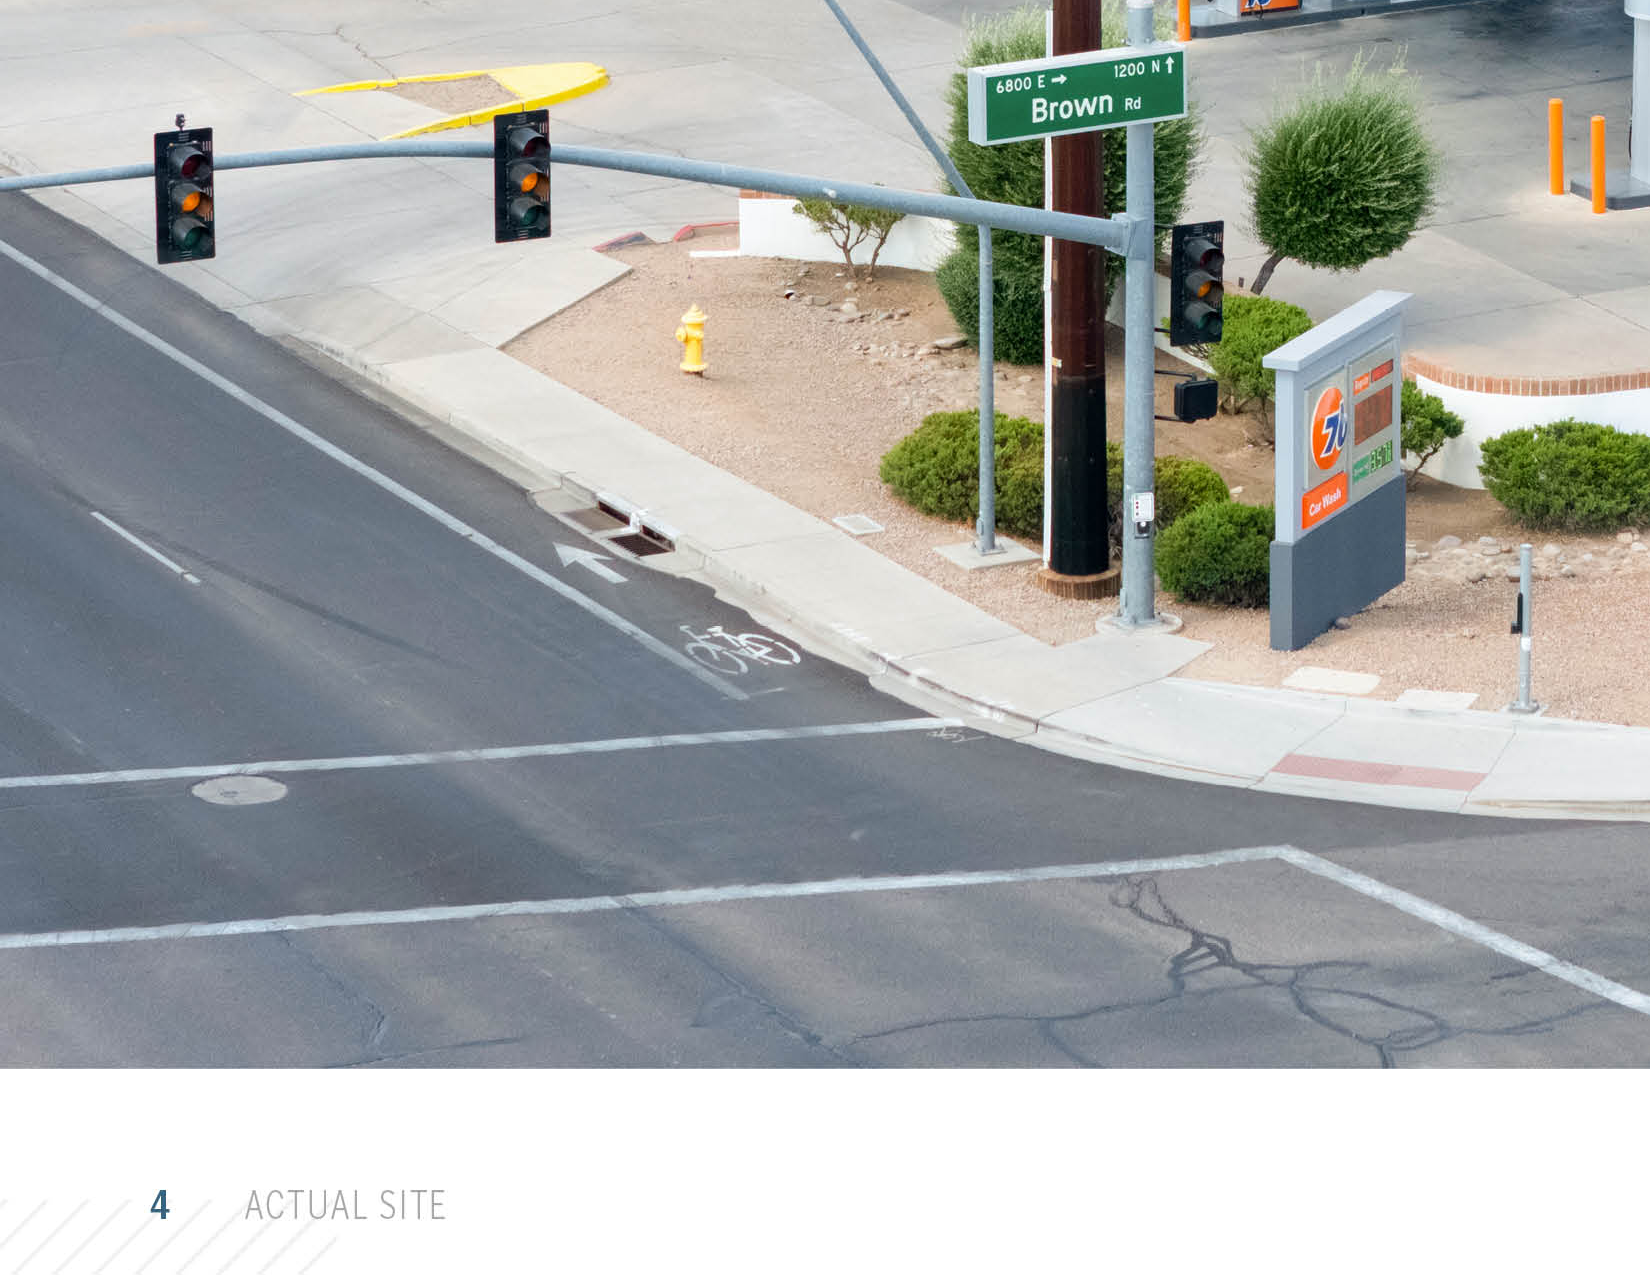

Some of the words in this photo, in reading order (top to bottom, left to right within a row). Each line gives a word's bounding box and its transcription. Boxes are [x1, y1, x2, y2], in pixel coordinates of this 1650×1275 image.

[996, 77, 1032, 93] 6800
[1038, 75, 1045, 88] E
[1114, 62, 1145, 78] 1200
[1152, 60, 1160, 73] N
[1032, 95, 1113, 124] Brown
[1125, 96, 1141, 111] Rd
[1319, 398, 1347, 458] 76
[1309, 501, 1322, 517] Car
[1322, 488, 1342, 510] Wash
